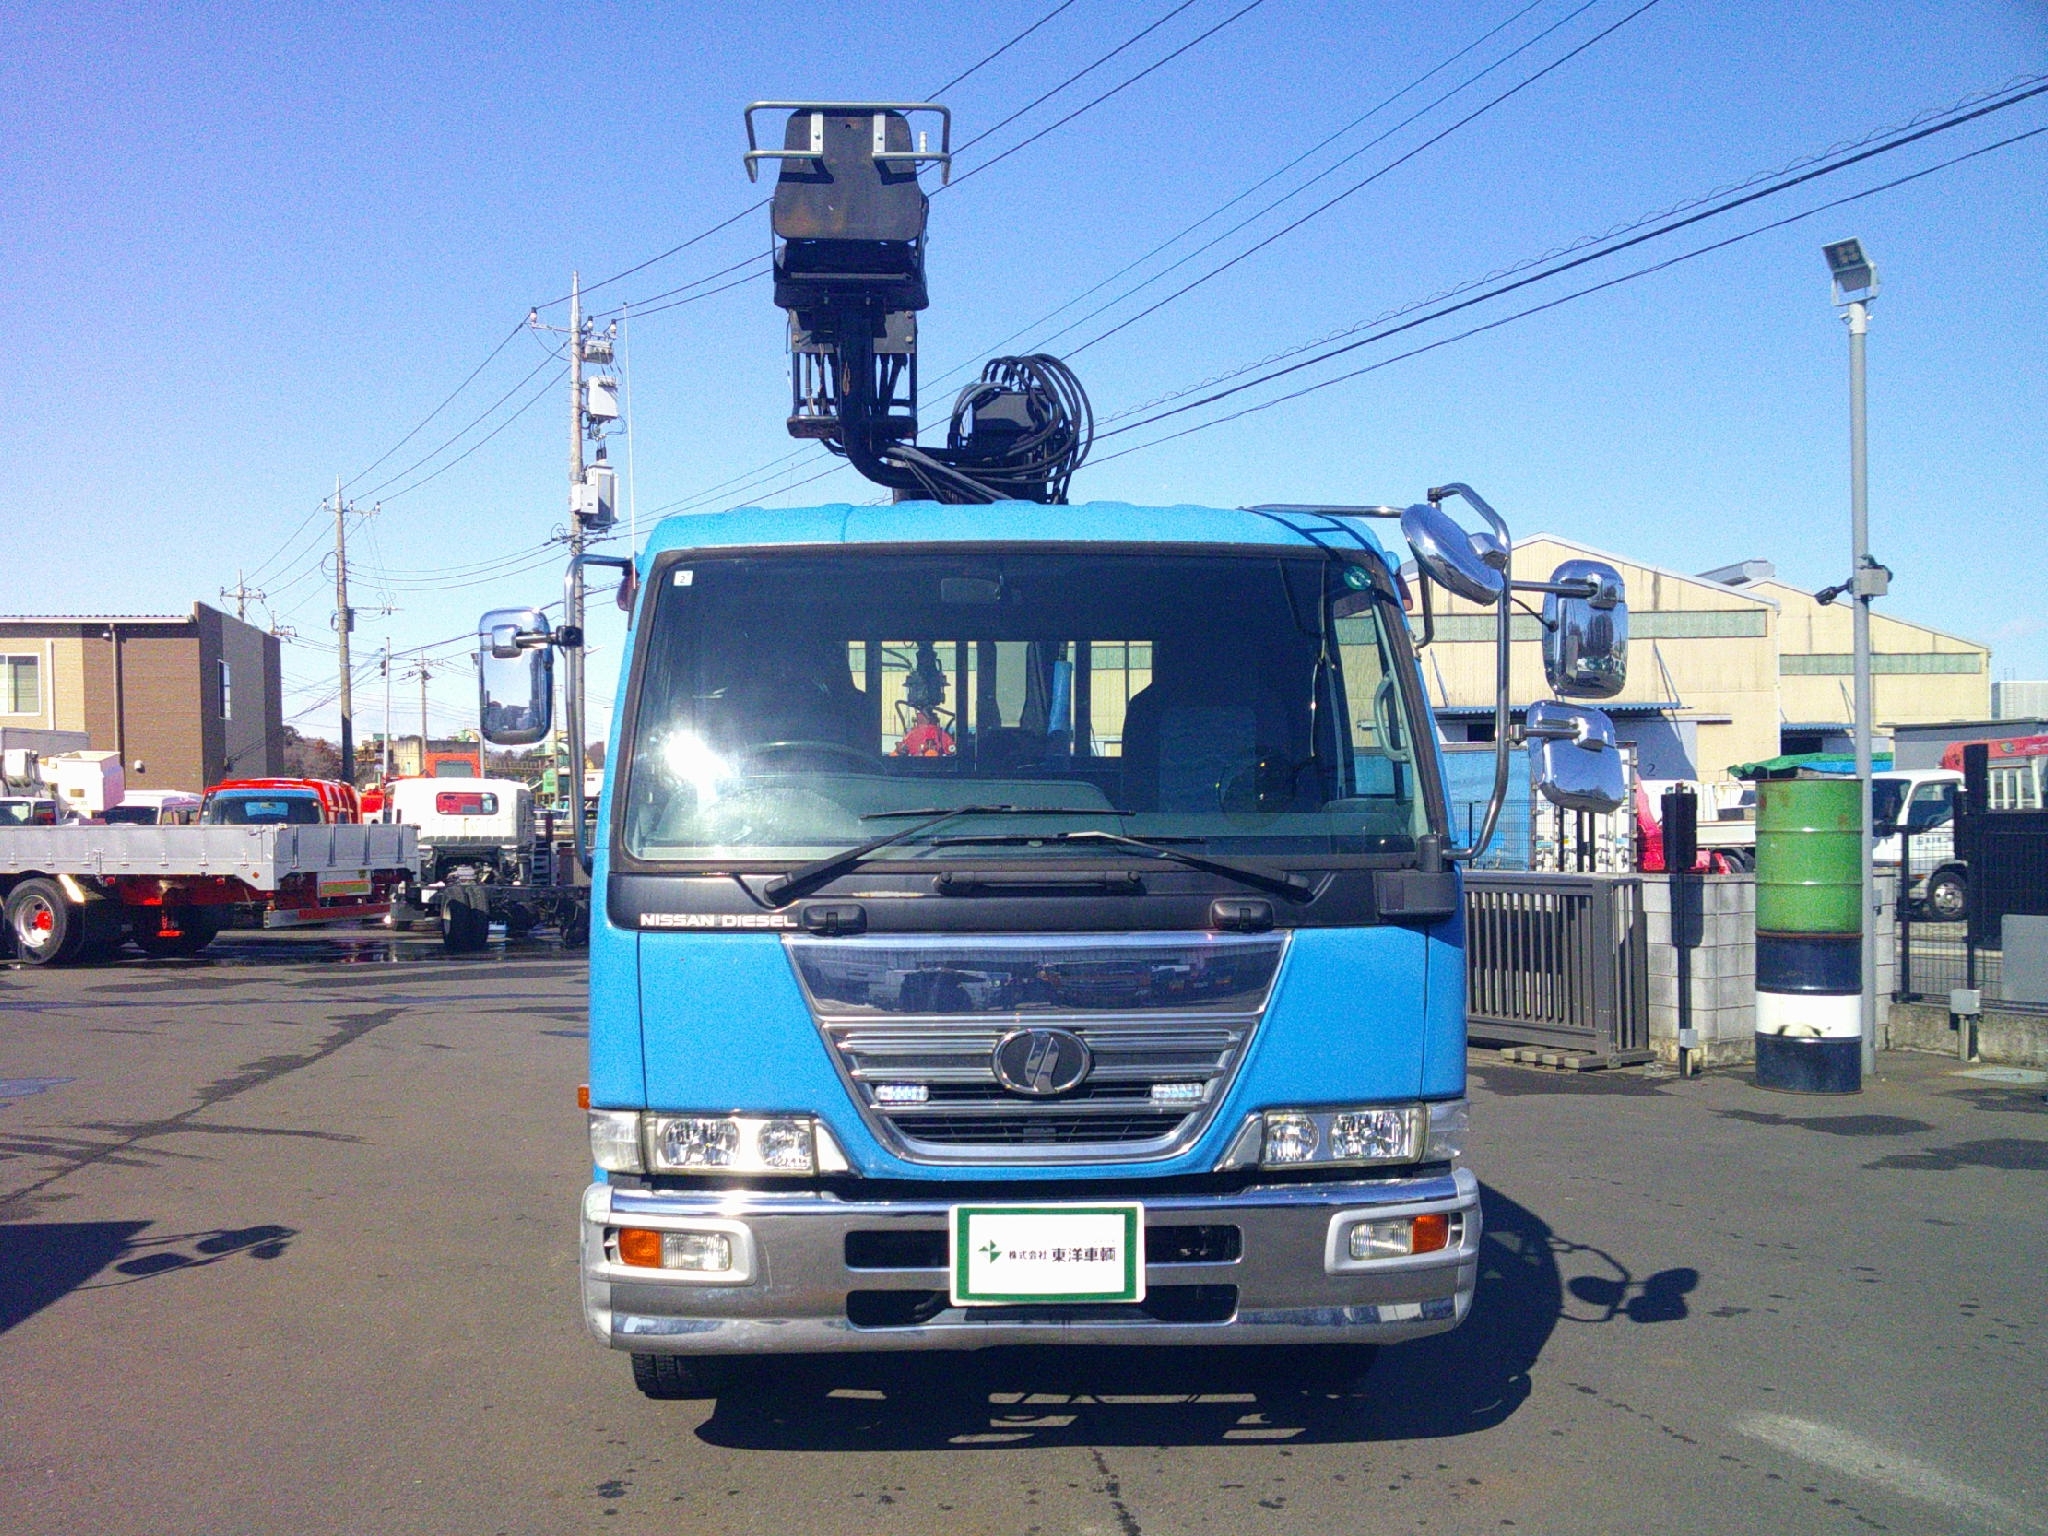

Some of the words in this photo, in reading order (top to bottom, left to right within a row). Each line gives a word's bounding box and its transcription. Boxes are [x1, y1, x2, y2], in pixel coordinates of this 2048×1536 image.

[640, 912, 716, 927] NISSAN
[720, 913, 798, 928] DIESEL
[1008, 1249, 1048, 1261] 株式会社
